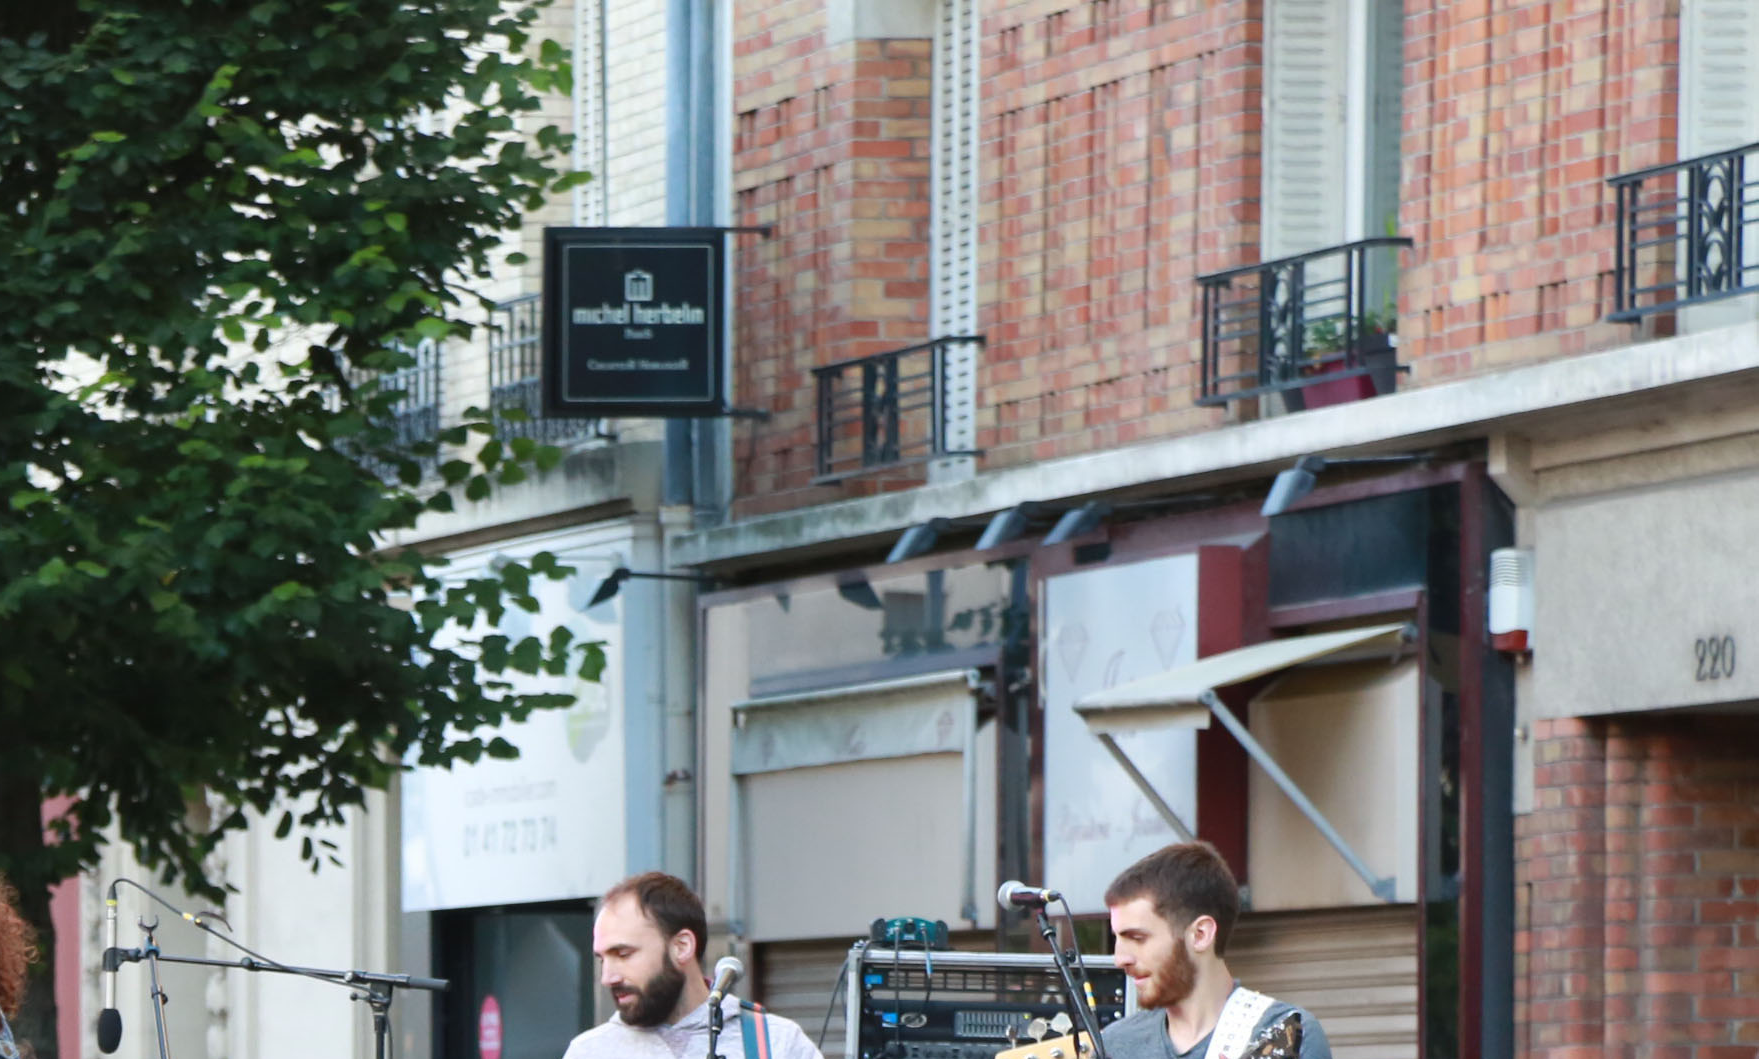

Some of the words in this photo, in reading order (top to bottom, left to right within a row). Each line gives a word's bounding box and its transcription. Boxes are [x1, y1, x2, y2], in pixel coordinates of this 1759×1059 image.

[572, 302, 631, 325] michel
[633, 302, 705, 325] herbelin
[1694, 635, 1735, 682] 220
